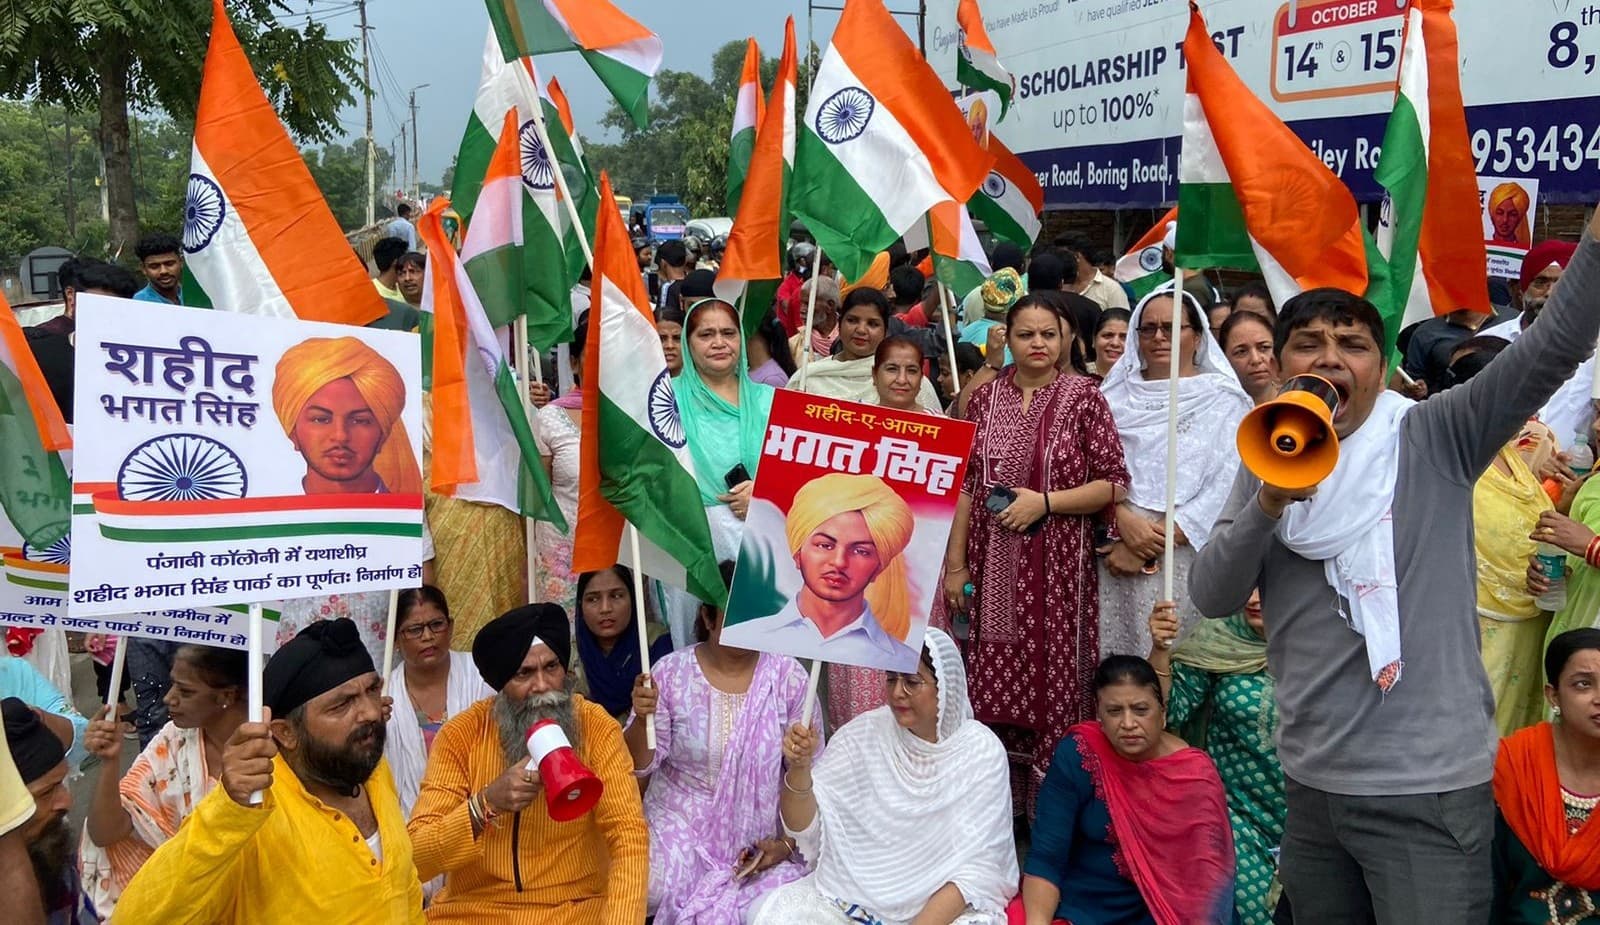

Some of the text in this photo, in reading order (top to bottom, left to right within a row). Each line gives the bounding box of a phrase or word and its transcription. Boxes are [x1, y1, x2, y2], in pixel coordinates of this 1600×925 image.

[997, 16, 1010, 28] have
[1011, 10, 1029, 24] Made
[1087, 9, 1106, 22] have
[1312, 2, 1378, 25] OCTOBER
[1020, 25, 1246, 99] SCHOLARSHIP TST
[1053, 107, 1076, 131] up
[1080, 102, 1097, 124] to
[1052, 162, 1084, 189] Road,
[1087, 160, 1128, 191] Boring
[1132, 158, 1172, 186] Road,
[100, 336, 259, 395] शहीद
[100, 391, 260, 429] भगत सिंह
[764, 424, 870, 475] भगत
[146, 544, 368, 570] पंजाबी कॉलोनी में यथाशीघ्र
[73, 584, 130, 603] शहीद
[134, 583, 187, 598] भगत
[191, 577, 231, 595] सिंह
[233, 574, 273, 592] पार्क
[276, 575, 302, 589] का
[356, 565, 404, 583] निर्माण
[407, 564, 422, 579] हो
[24, 595, 63, 608] आम
[162, 608, 211, 622] जमीन
[214, 612, 233, 625] में
[39, 613, 57, 626] से
[61, 617, 100, 630] जल्द
[104, 620, 142, 632] पार्क
[144, 624, 169, 636] का
[174, 625, 227, 643] निर्माण
